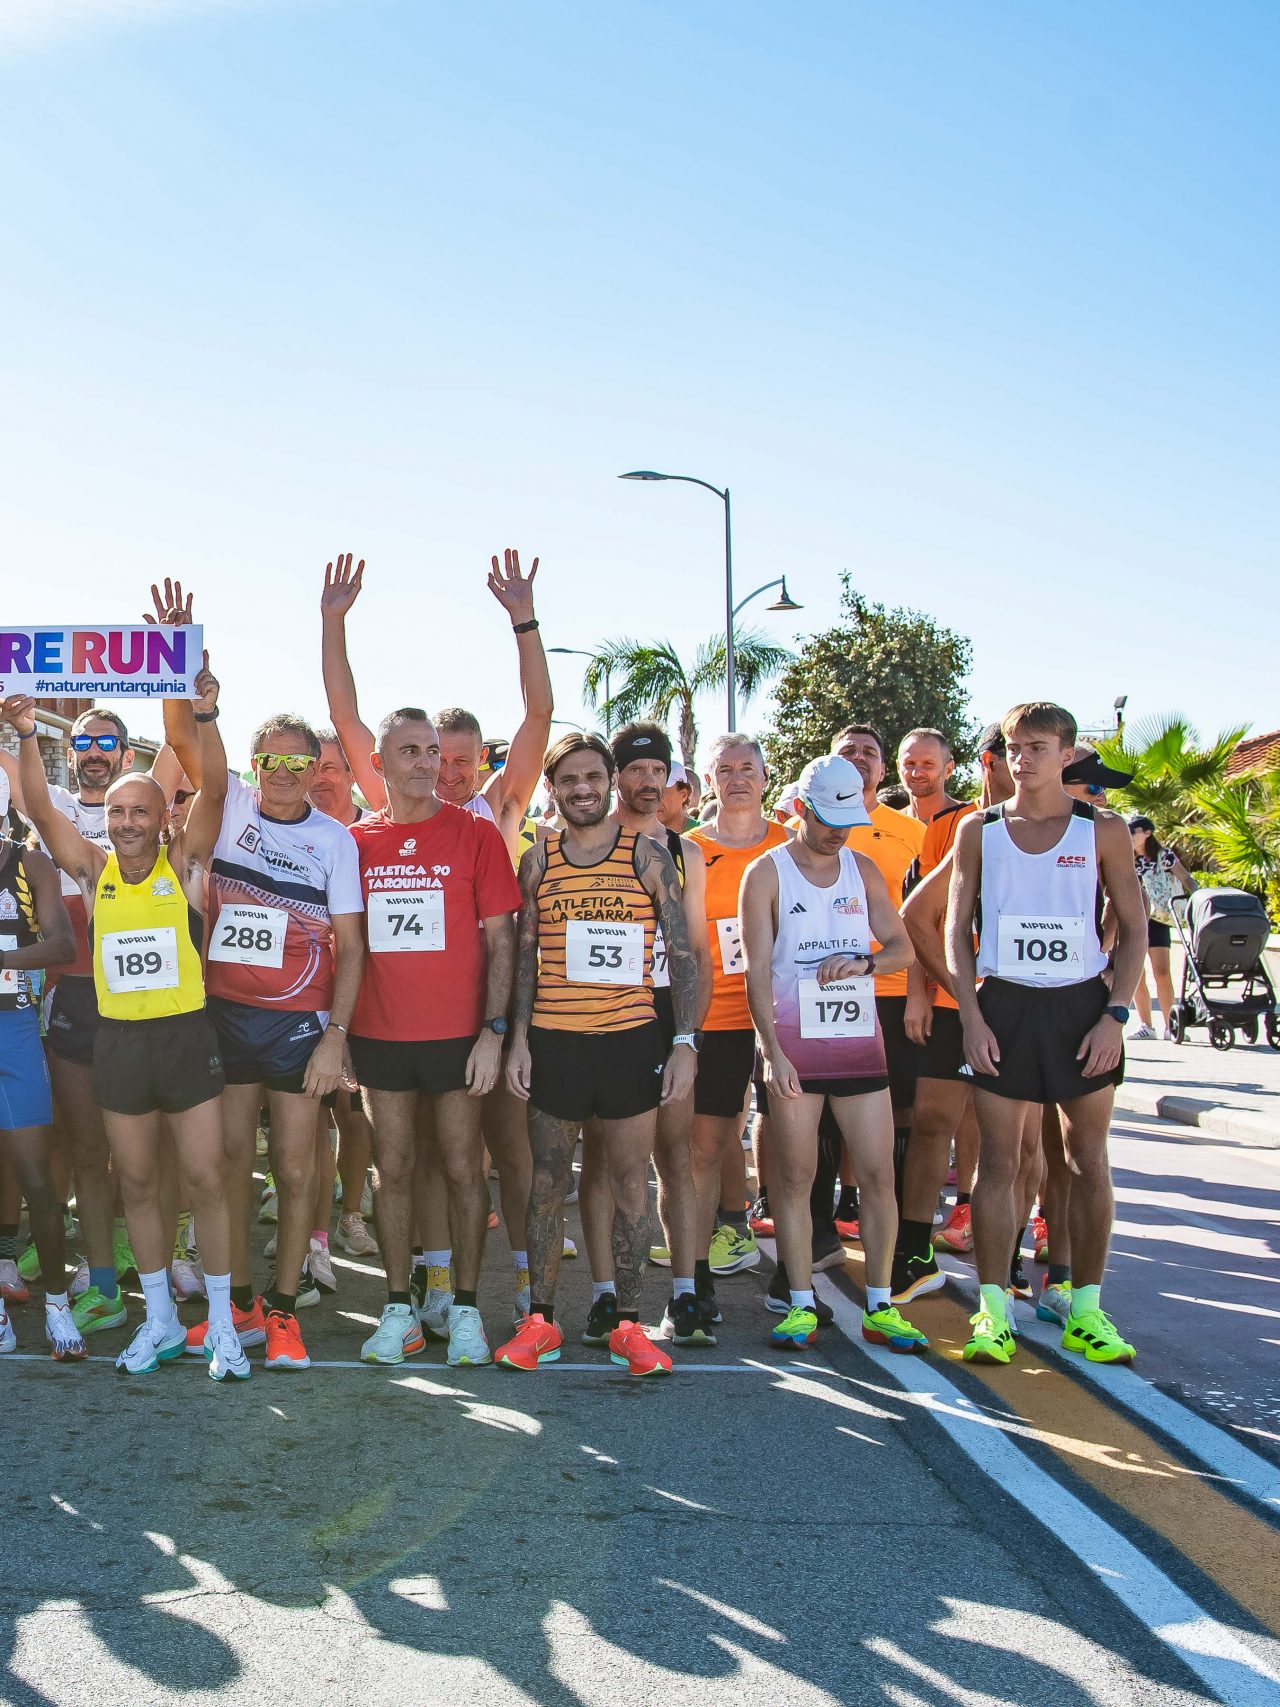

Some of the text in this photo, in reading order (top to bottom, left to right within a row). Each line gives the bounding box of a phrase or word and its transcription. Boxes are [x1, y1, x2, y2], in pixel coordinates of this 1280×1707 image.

[72, 631, 186, 675] RUN
[35, 679, 186, 696] #natureruntarquinia
[364, 865, 427, 877] ATLETICA
[368, 877, 443, 889] TARQUINIA
[552, 896, 625, 911] ATLETICA
[234, 910, 268, 920] KIPRUN
[574, 909, 634, 921] SBARRA
[388, 914, 423, 936] 74
[587, 927, 627, 936] KIPRUN
[1020, 922, 1064, 930] KIPRUN
[117, 935, 156, 945] KIPRUN
[221, 925, 273, 952] 288
[798, 939, 861, 951] APPALTI F.C.
[588, 945, 623, 968] 53
[1013, 938, 1068, 962] 108
[114, 951, 162, 977] 189
[815, 1000, 860, 1023] 179
